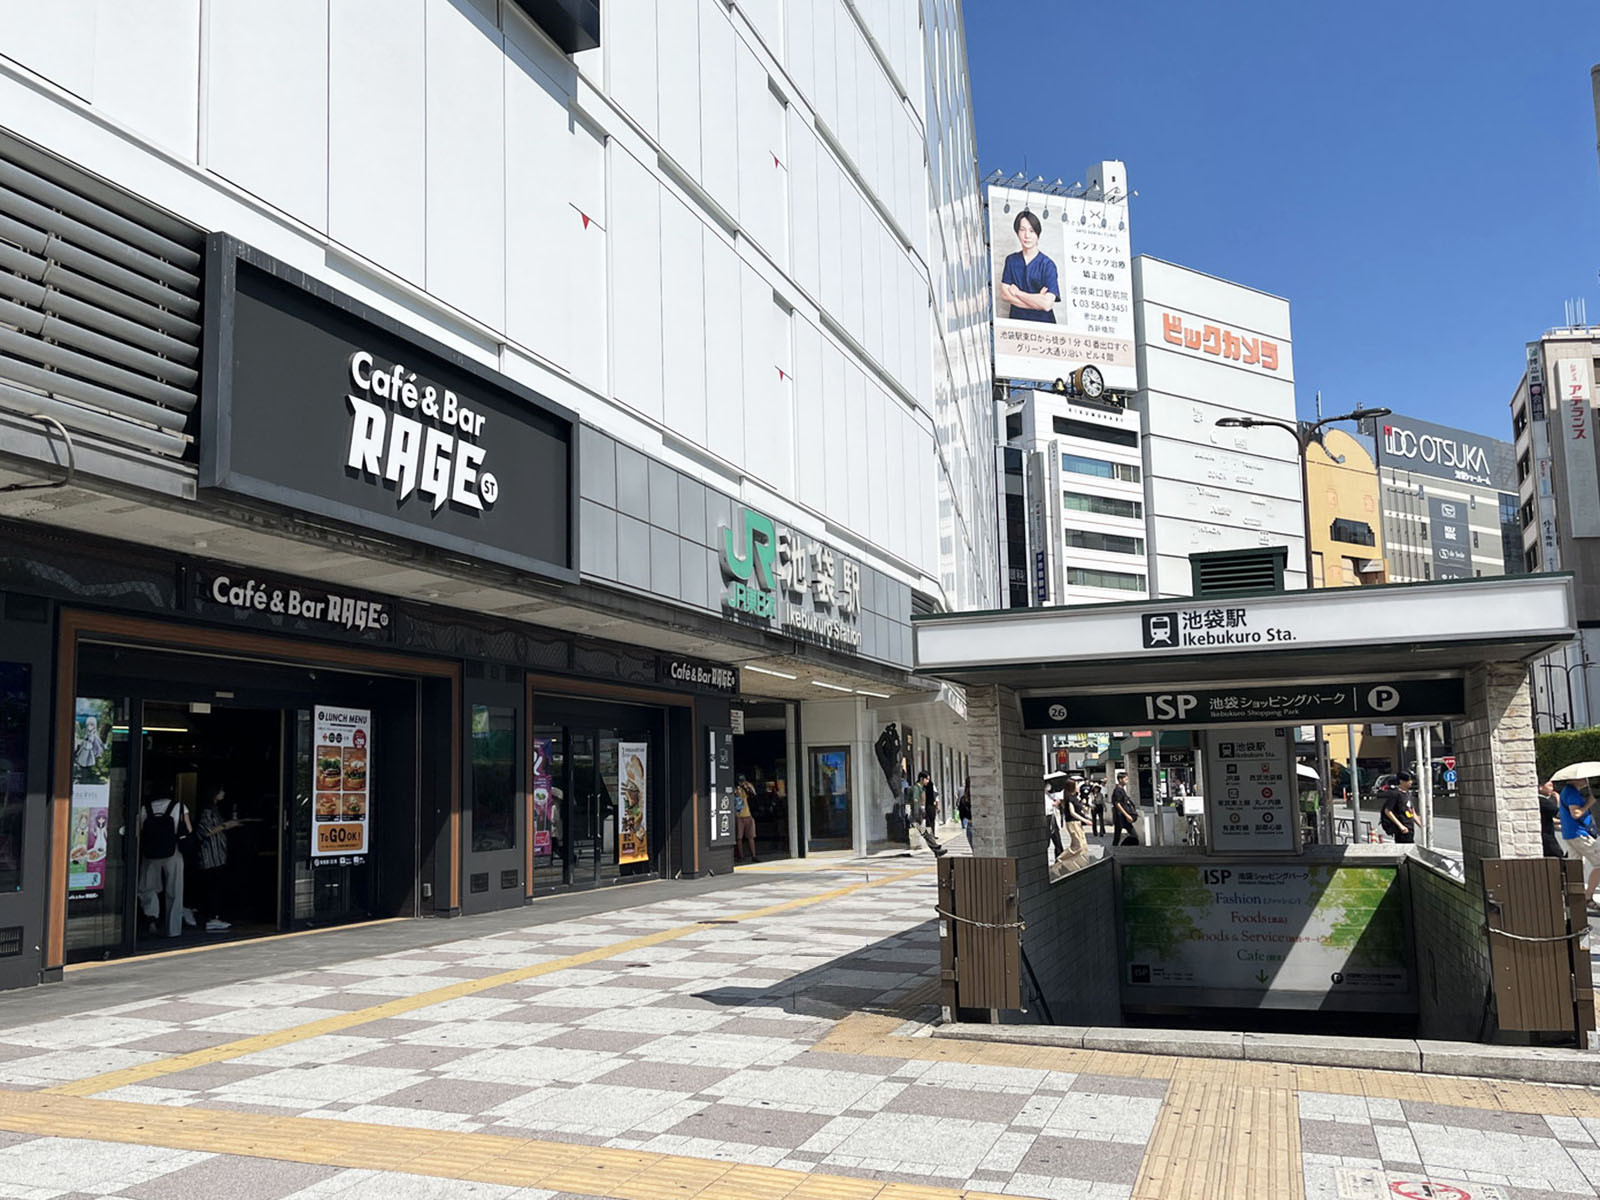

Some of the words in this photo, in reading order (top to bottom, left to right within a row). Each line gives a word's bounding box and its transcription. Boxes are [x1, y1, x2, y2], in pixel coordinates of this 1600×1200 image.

[1079, 299, 1089, 308] 03
[1091, 300, 1109, 311] 5843
[1111, 303, 1128, 312] 3451
[1162, 312, 1279, 371] ビックカメラ
[351, 350, 419, 410] Café
[421, 385, 440, 419] &
[442, 389, 486, 437] Bar
[347, 394, 487, 511] RAGE
[1383, 424, 1418, 459] IDC
[1419, 433, 1491, 475] OTSUKA
[722, 507, 776, 590] JR
[778, 530, 861, 615] 池袋駅
[212, 575, 268, 610] Café
[269, 590, 285, 613] &
[288, 590, 326, 619] Bar
[327, 594, 383, 632] RAGE
[786, 603, 835, 638] Ikebukuro
[834, 622, 862, 646] Station
[1182, 608, 1247, 630] 池袋駅
[1183, 629, 1262, 646] Ikebukuro
[1266, 628, 1297, 642] Sta.
[670, 662, 691, 681] Café
[691, 667, 697, 681] &
[697, 667, 712, 684] Bar
[711, 667, 733, 689] RAGE
[1050, 707, 1066, 718] 26
[1145, 693, 1198, 721] ISP
[1209, 692, 1346, 710] 池袋ショッピングパーク
[1376, 689, 1393, 708] P
[1210, 710, 1245, 718] Ikebukuro
[1247, 709, 1283, 718] Shopping
[325, 712, 348, 723] LUNCH
[349, 714, 368, 725] MENU
[1170, 754, 1184, 762] ISP
[329, 827, 346, 843] GO
[1204, 869, 1232, 885] ISP
[1215, 892, 1262, 905] Fashion
[1231, 911, 1268, 924] Foods
[1190, 930, 1230, 943] Goods
[1241, 930, 1286, 943] Service
